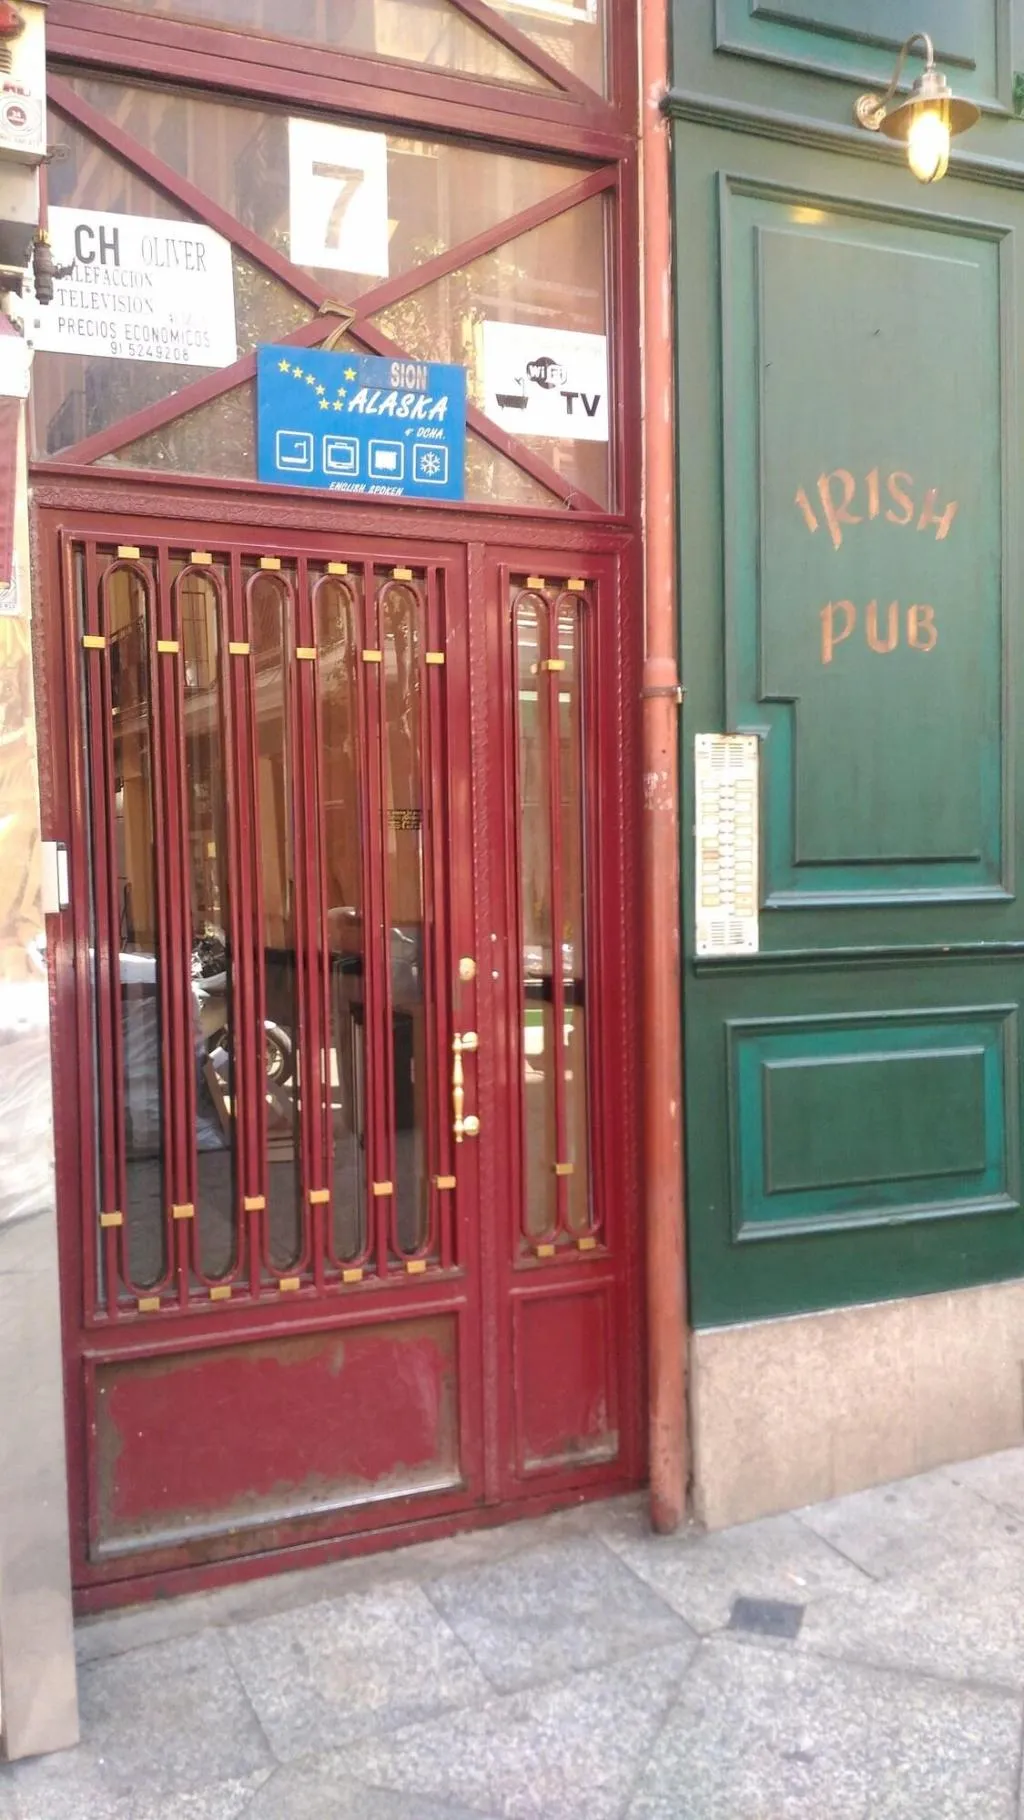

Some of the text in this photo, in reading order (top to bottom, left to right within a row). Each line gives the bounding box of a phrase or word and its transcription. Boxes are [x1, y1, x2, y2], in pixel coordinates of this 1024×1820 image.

[312, 161, 364, 249] 7
[74, 224, 207, 272] CH OLIVER
[57, 262, 153, 288] LEFACCION
[57, 288, 154, 314] TELEVISION
[58, 316, 211, 348] PRECIOS ECONOMICOS
[110, 340, 123, 355] 91
[391, 362, 427, 389] SION
[348, 387, 449, 422] ALASKA
[560, 391, 601, 417] TV
[329, 481, 367, 493] ENGLISH
[795, 465, 958, 551] IRISH
[819, 598, 938, 666] PUB
